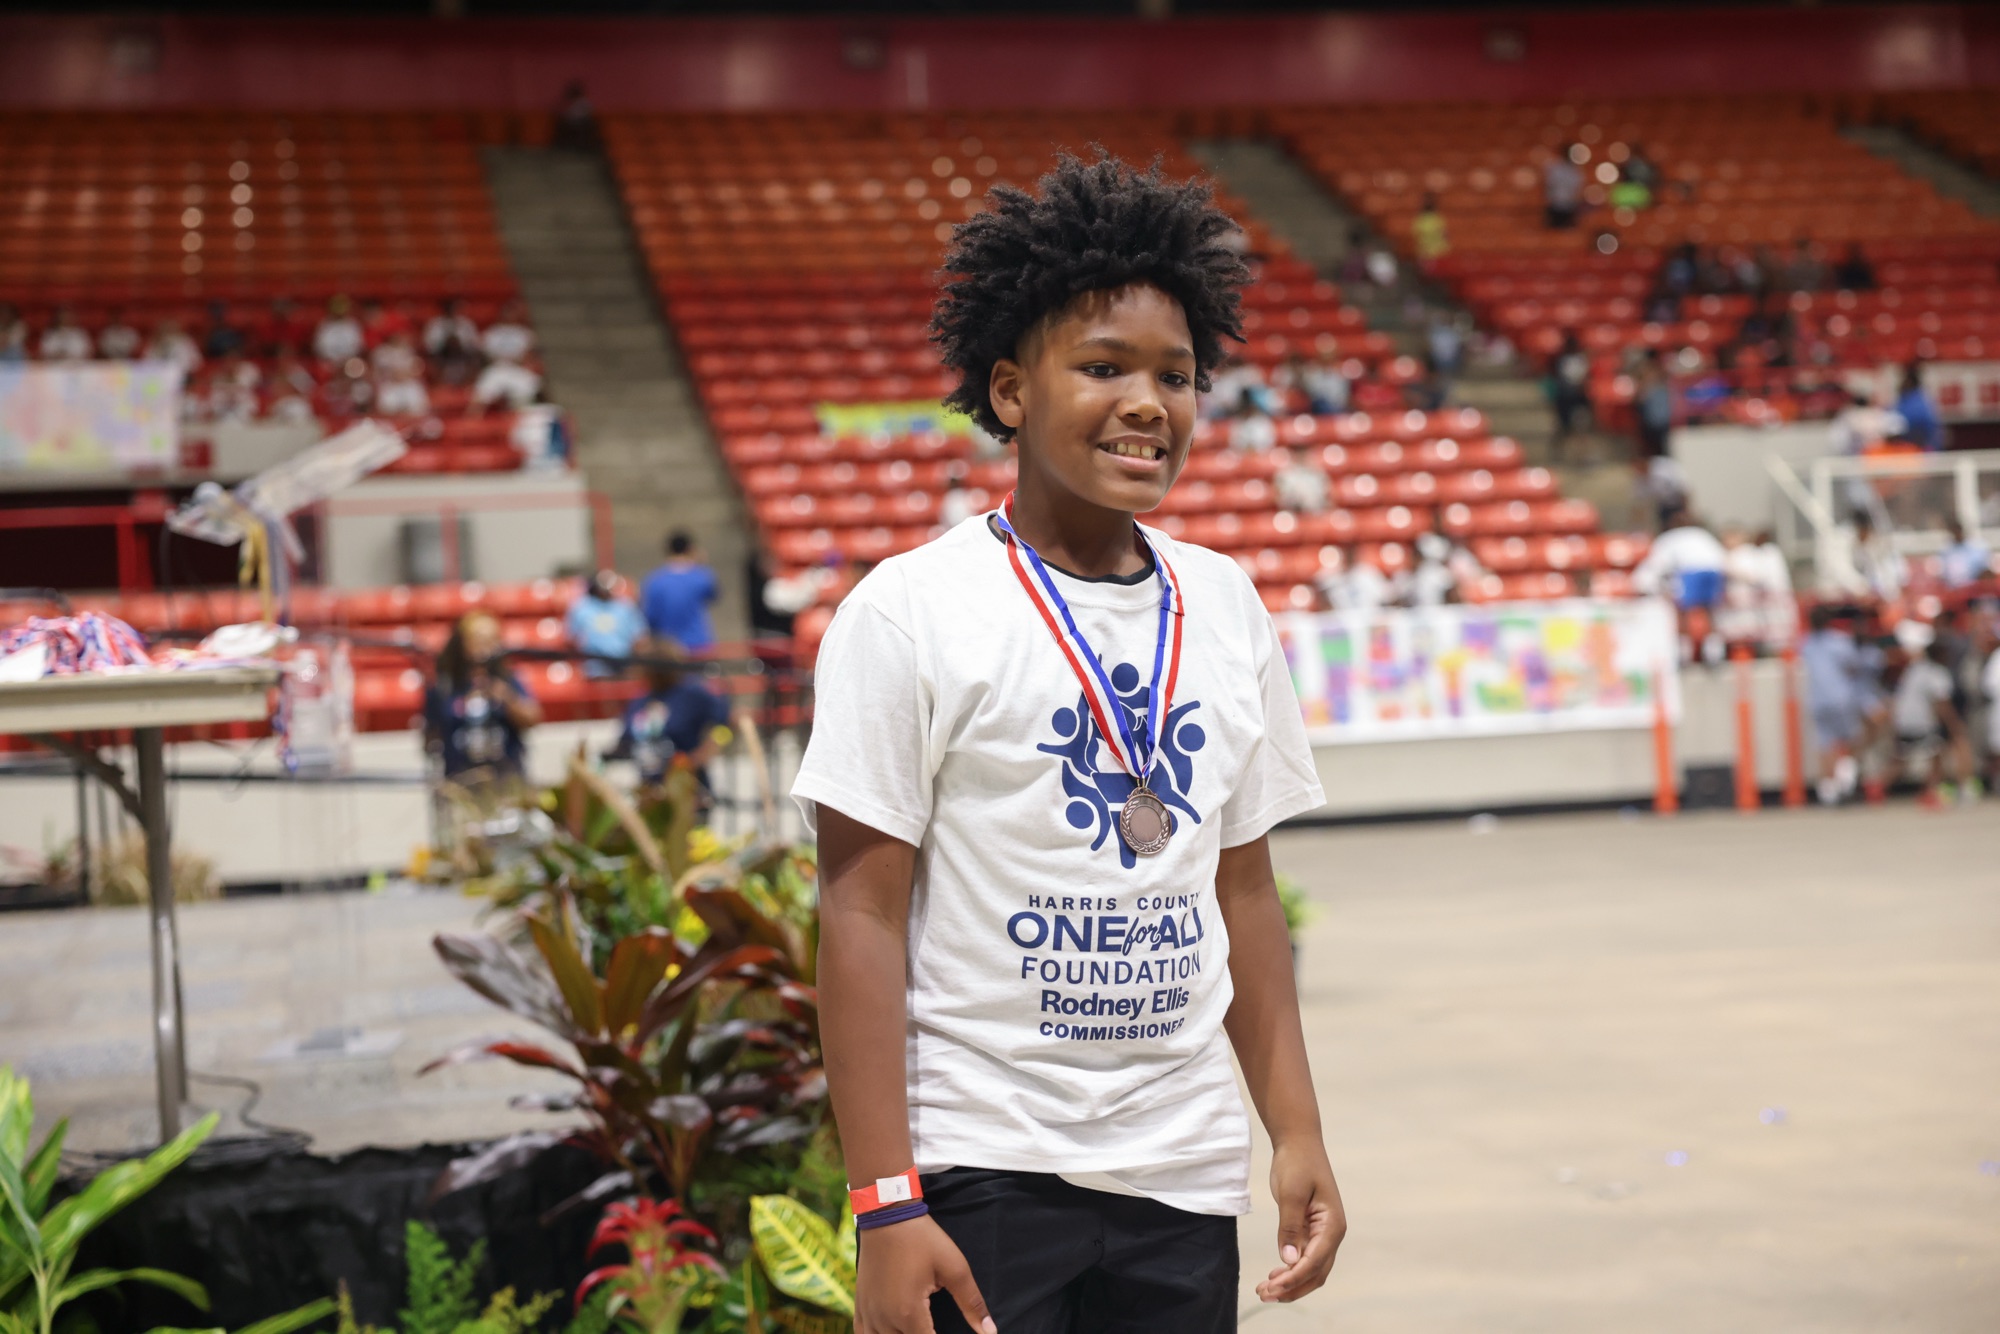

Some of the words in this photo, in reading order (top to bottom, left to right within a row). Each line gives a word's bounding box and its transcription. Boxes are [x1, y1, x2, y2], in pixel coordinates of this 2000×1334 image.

[1029, 894, 1117, 911] HARRIS
[1007, 911, 1128, 952] ONE
[1021, 950, 1201, 985] FOUNDATION
[1041, 989, 1146, 1021] Rodney
[1151, 986, 1190, 1014] Ellis
[1039, 1017, 1185, 1040] COMMISSIONER
